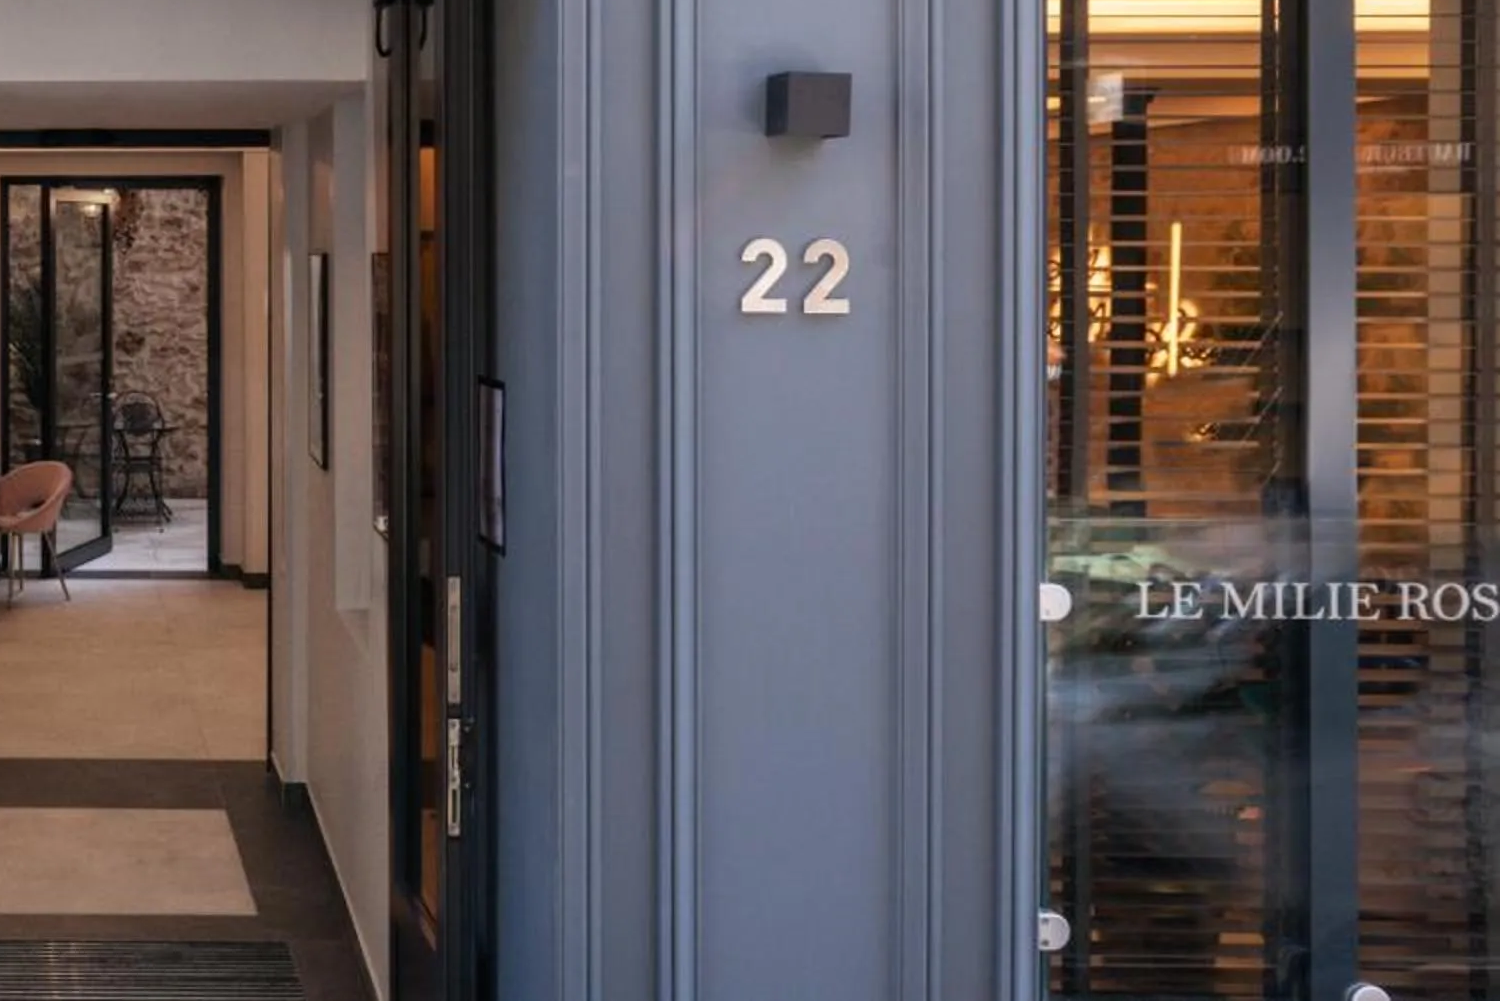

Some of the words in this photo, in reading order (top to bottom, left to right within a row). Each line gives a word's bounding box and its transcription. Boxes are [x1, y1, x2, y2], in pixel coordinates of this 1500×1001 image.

[741, 238, 850, 314] 22
[1134, 582, 1205, 619] LE
[1221, 582, 1381, 620] MILIE
[1395, 582, 1500, 621] ROS
